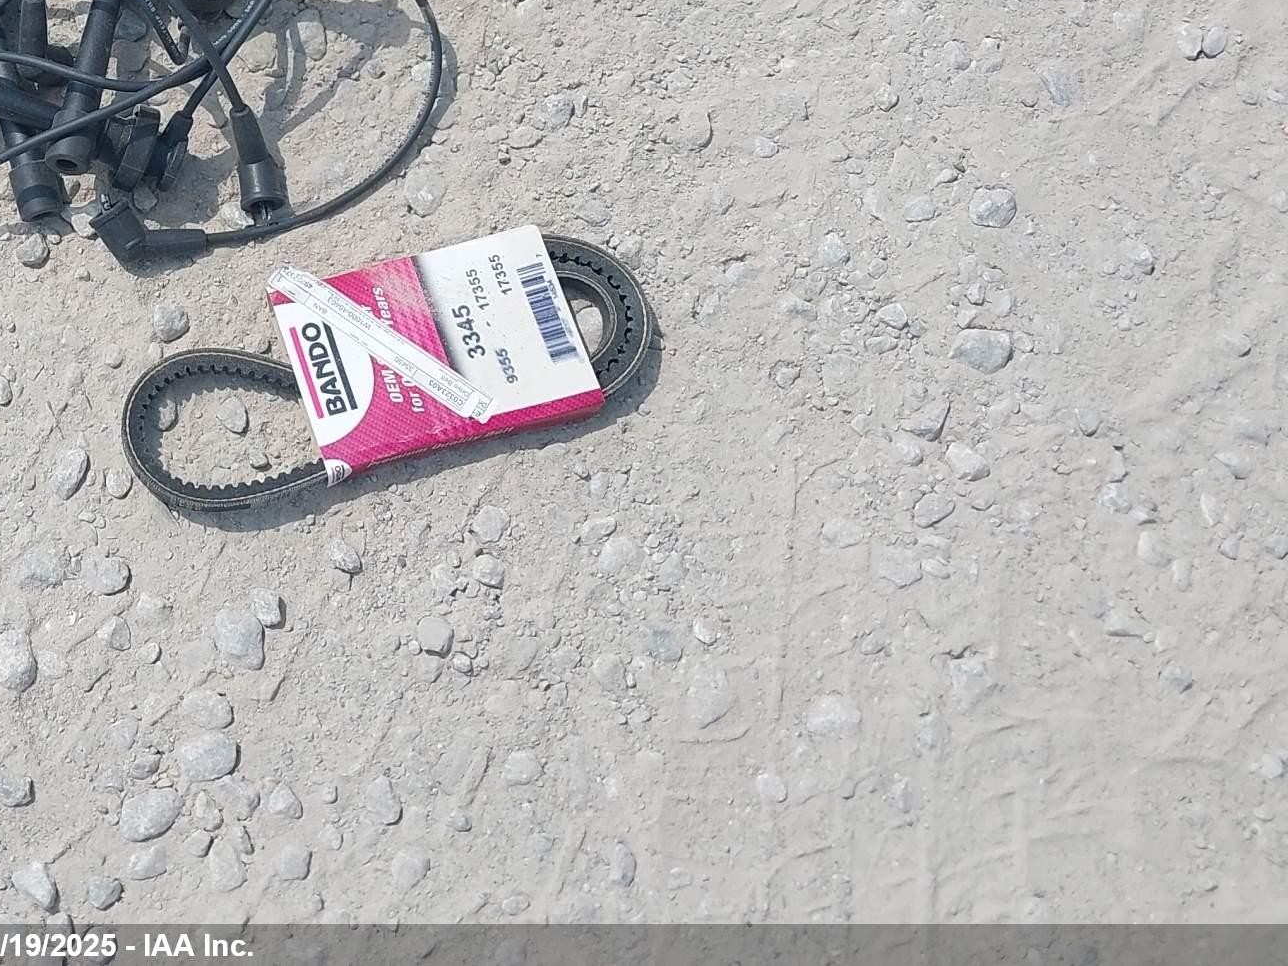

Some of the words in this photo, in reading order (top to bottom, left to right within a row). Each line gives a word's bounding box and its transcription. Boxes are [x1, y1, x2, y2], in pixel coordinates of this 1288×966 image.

[465, 269, 490, 310] 17355
[488, 254, 512, 295] 17355
[451, 305, 486, 359] 3345
[302, 322, 347, 416] BANDO
[381, 369, 404, 403] OEM
[496, 348, 518, 384] 9355
[409, 392, 425, 413] for
